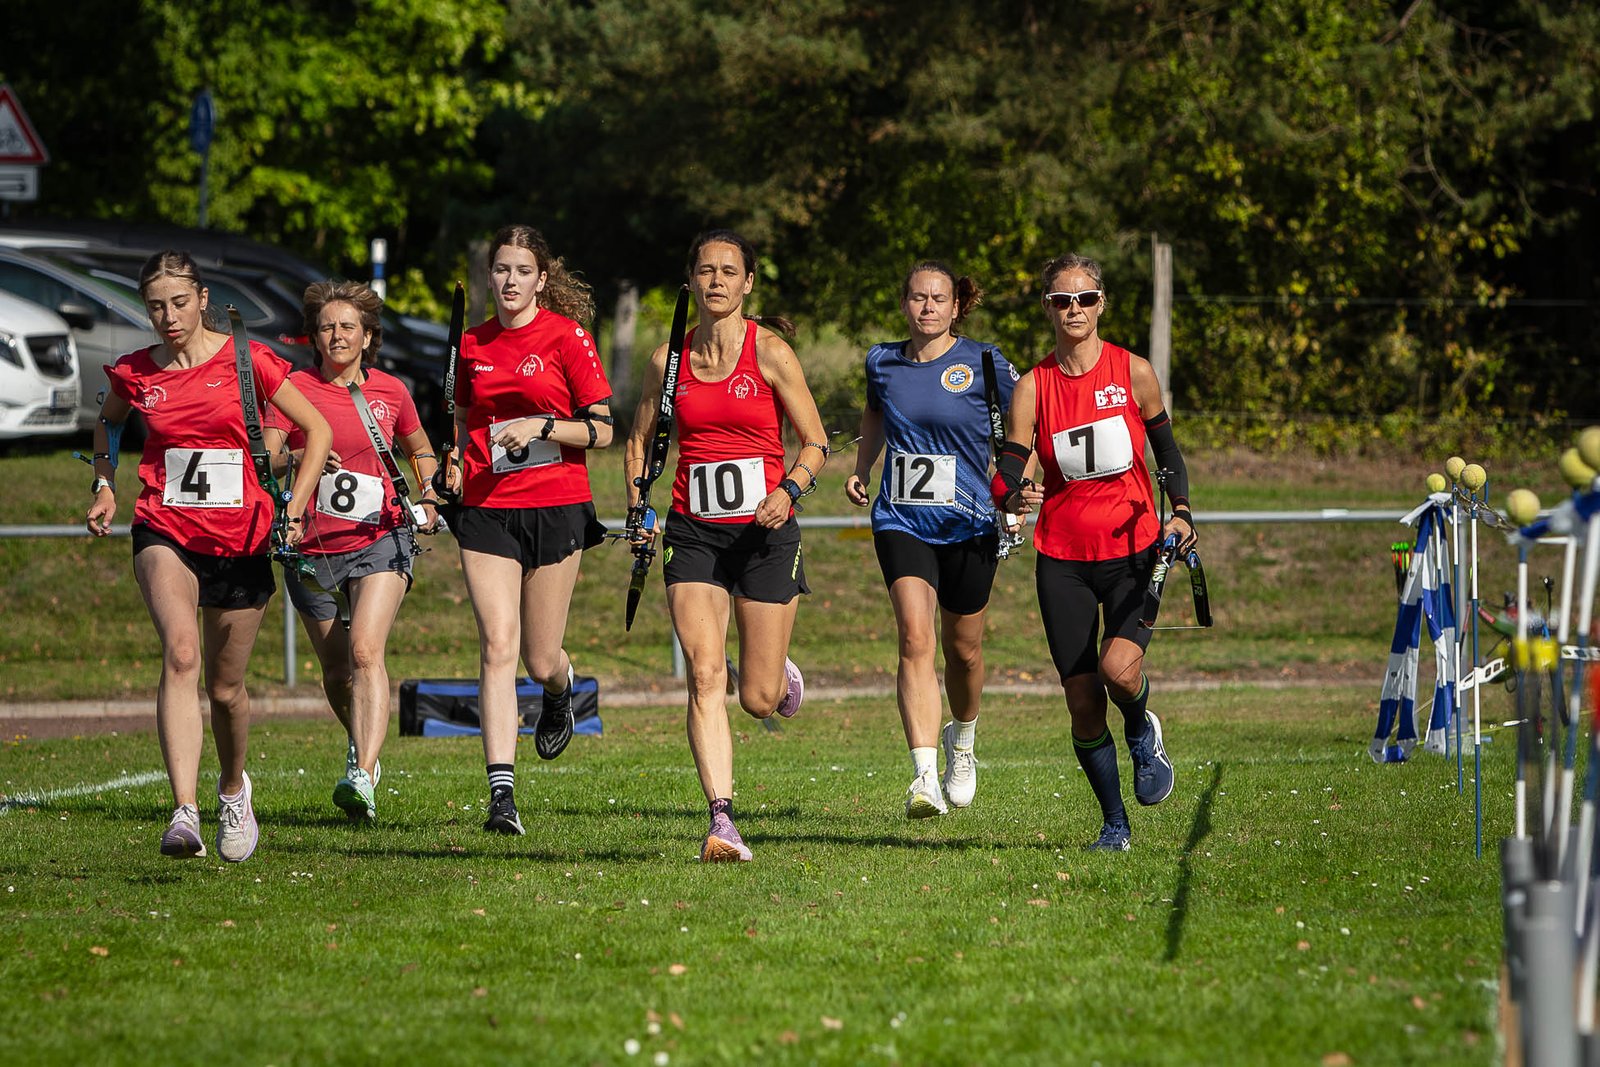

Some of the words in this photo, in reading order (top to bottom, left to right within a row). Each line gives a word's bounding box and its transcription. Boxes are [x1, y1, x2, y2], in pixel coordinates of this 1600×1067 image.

[474, 364, 494, 372] JAKO
[665, 350, 680, 396] ARCHERY
[241, 371, 256, 421] KINETIC
[368, 424, 385, 450] HOYT
[1068, 426, 1095, 473] 7
[180, 452, 210, 500] 4
[330, 473, 358, 513] 8
[693, 462, 744, 513] 10
[895, 456, 935, 501] 12
